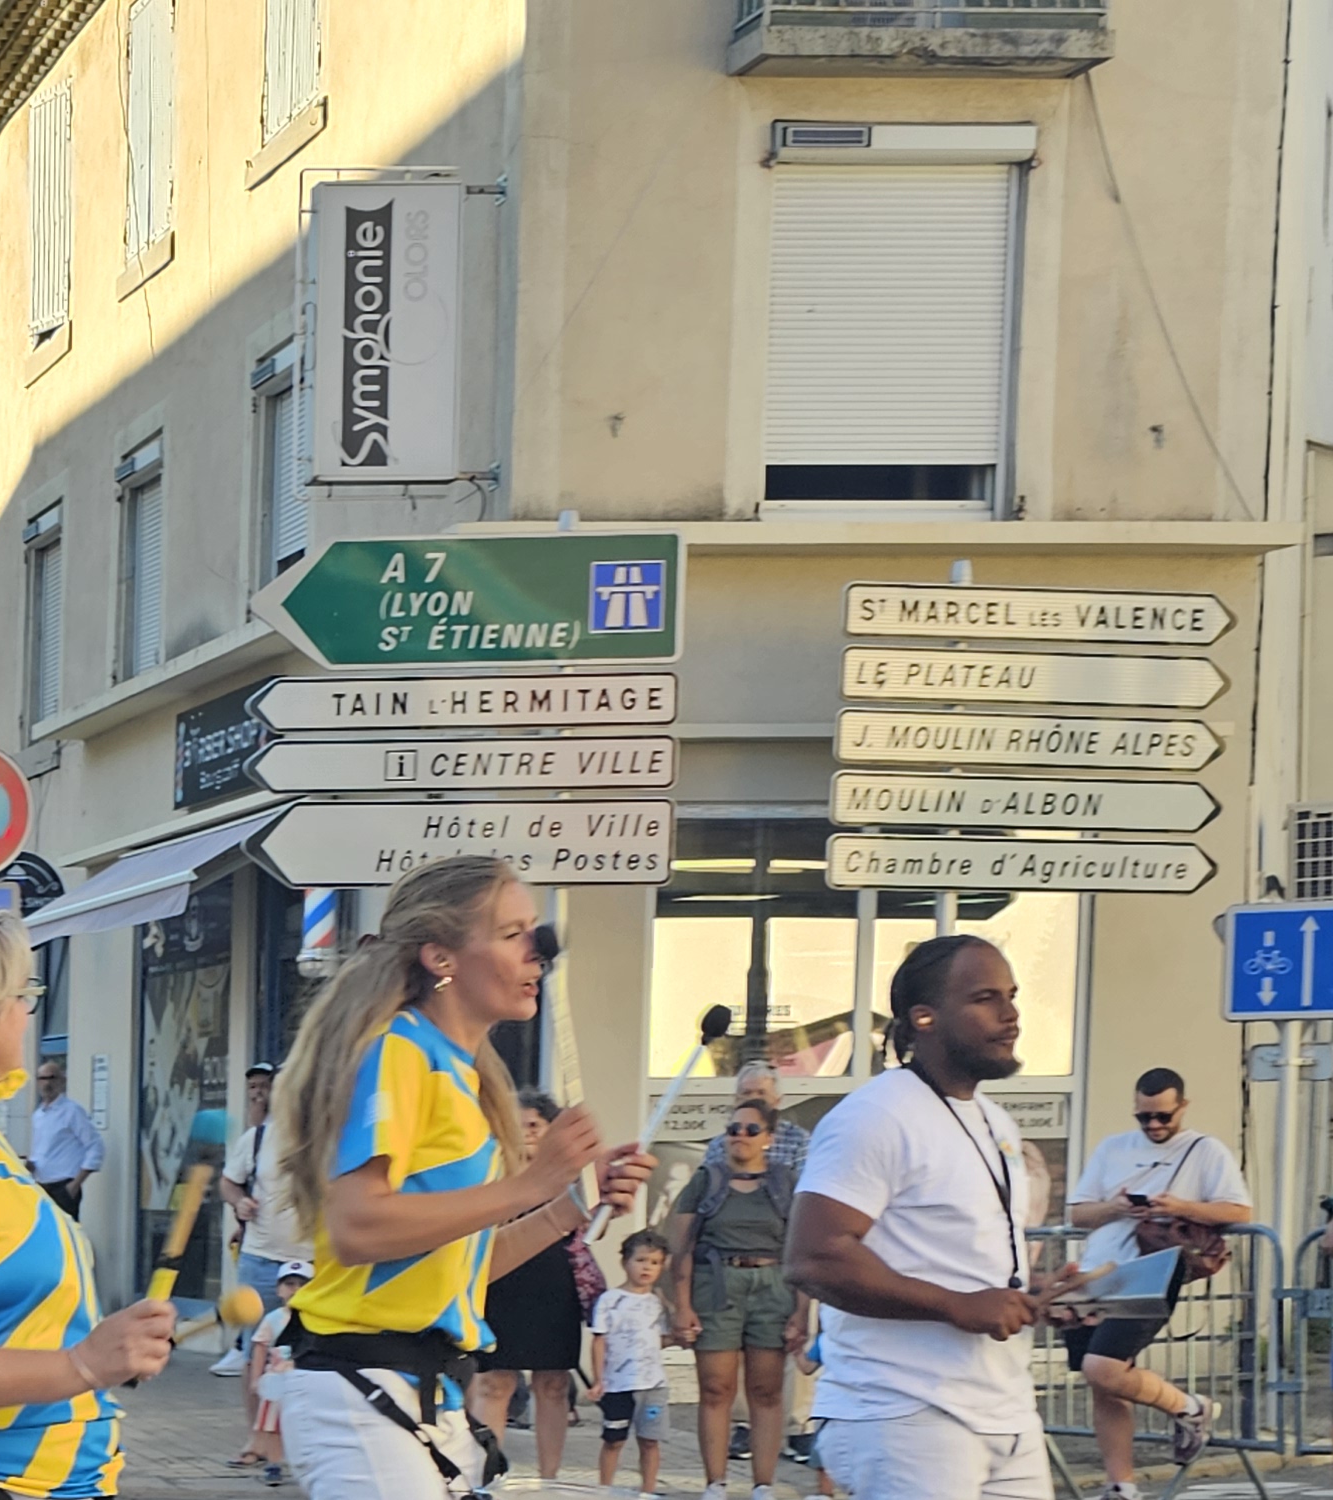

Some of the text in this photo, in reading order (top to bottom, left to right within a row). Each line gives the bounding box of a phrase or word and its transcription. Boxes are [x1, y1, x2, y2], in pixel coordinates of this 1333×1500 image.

[380, 552, 447, 584] A 7
[379, 590, 474, 620] (LYON
[898, 599, 1017, 626] MARCEL
[1075, 604, 1206, 632] VALENCE
[426, 617, 581, 651] ÉTIENNE)
[903, 662, 1037, 690] PLATEAU
[332, 692, 409, 716] TAIN
[852, 725, 874, 749] J.
[887, 726, 997, 752] MOULIN
[1111, 732, 1199, 757] ALPES
[431, 751, 557, 777] CENTRE
[578, 750, 665, 776] VILLE
[847, 787, 967, 813] MOULIN
[423, 813, 661, 839] Hôtel de Ville
[552, 847, 660, 872] Postes
[844, 849, 1189, 884] Chambre d'Agriculture
